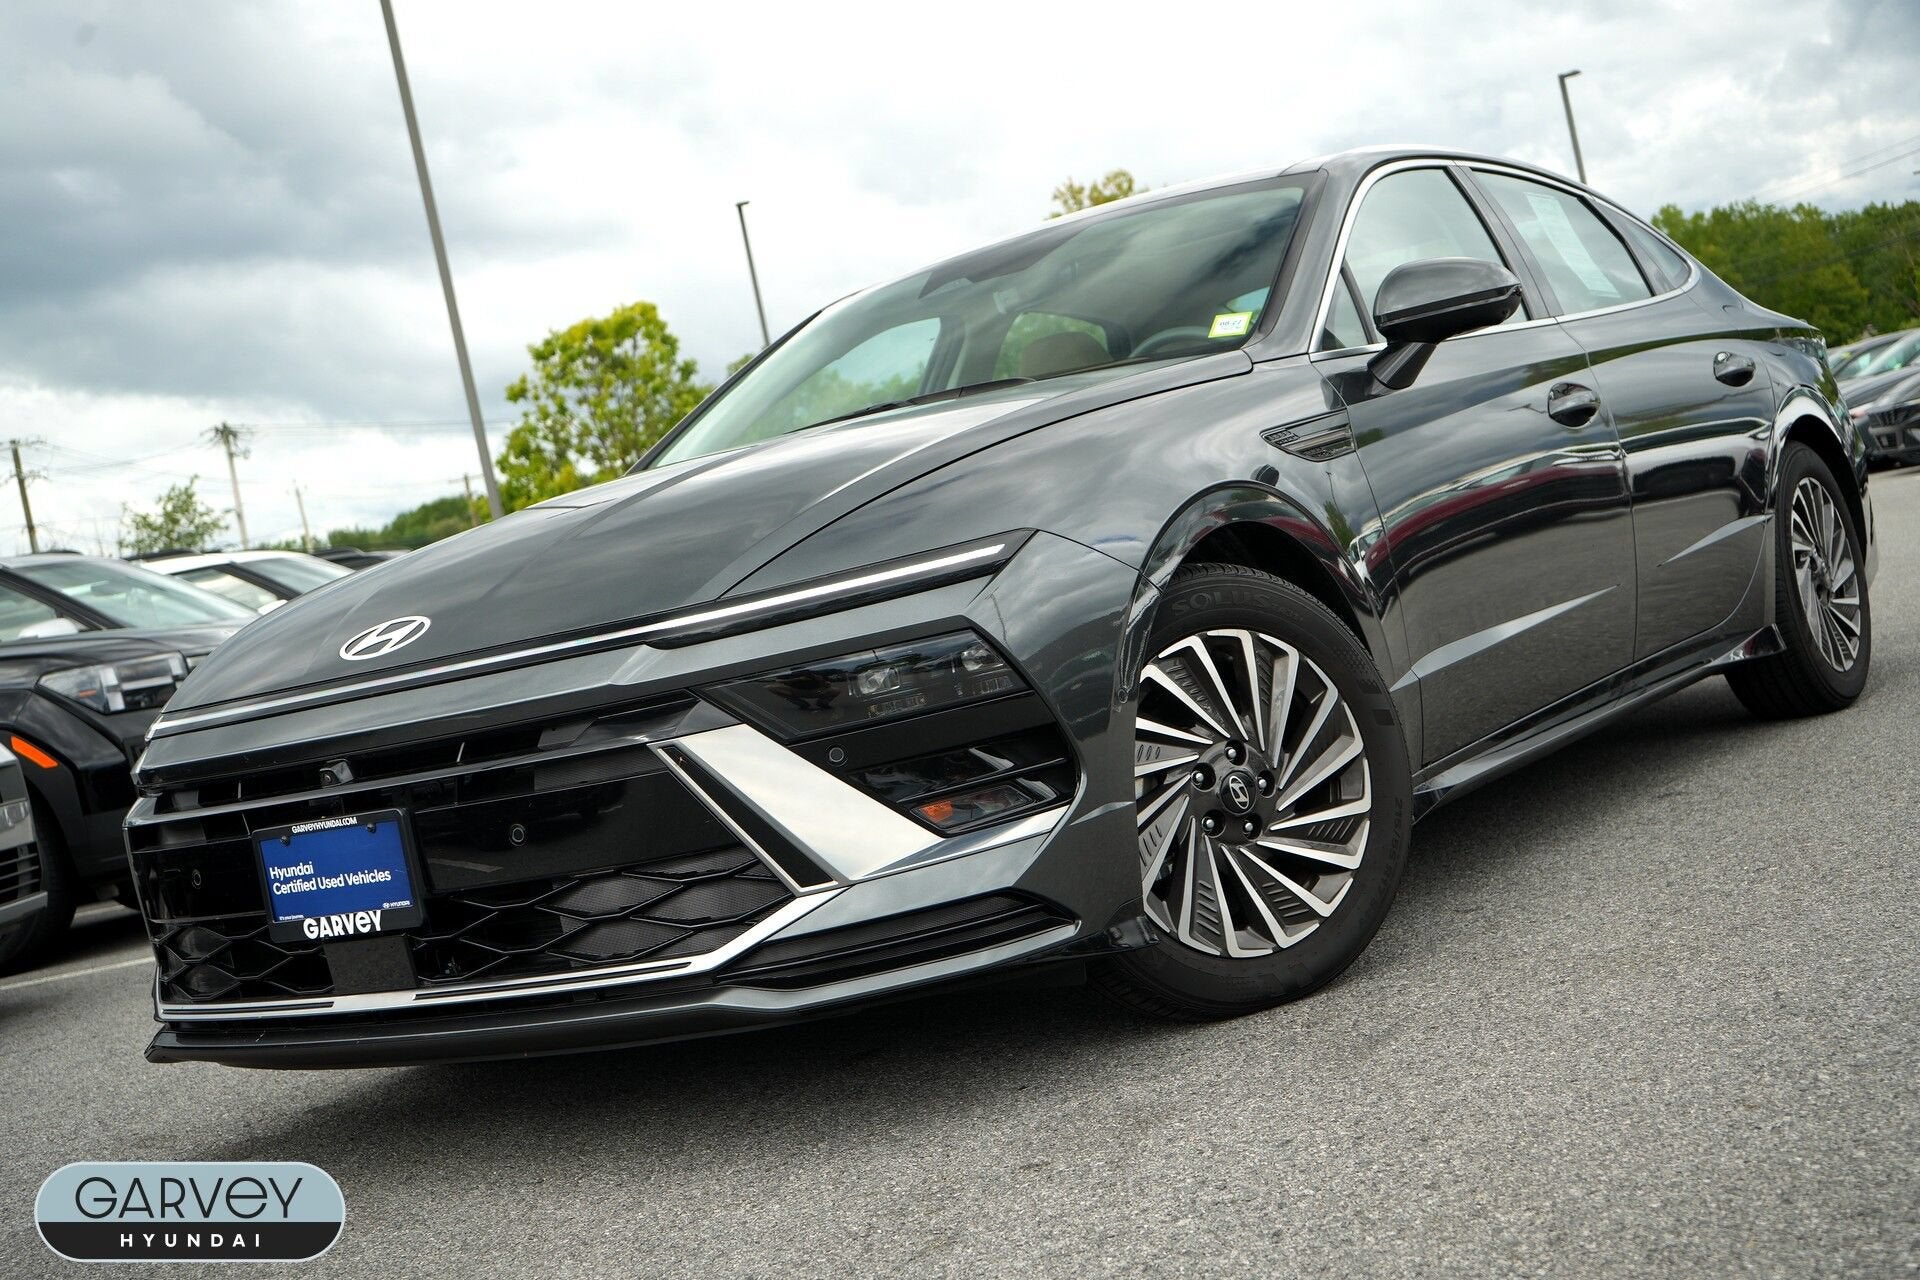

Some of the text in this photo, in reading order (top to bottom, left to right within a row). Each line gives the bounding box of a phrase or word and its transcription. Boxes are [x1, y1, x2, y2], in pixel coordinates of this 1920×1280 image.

[1172, 591, 1271, 616] SOLUS
[269, 861, 314, 880] Hyundai
[272, 869, 392, 895] Certified Used Vehicles
